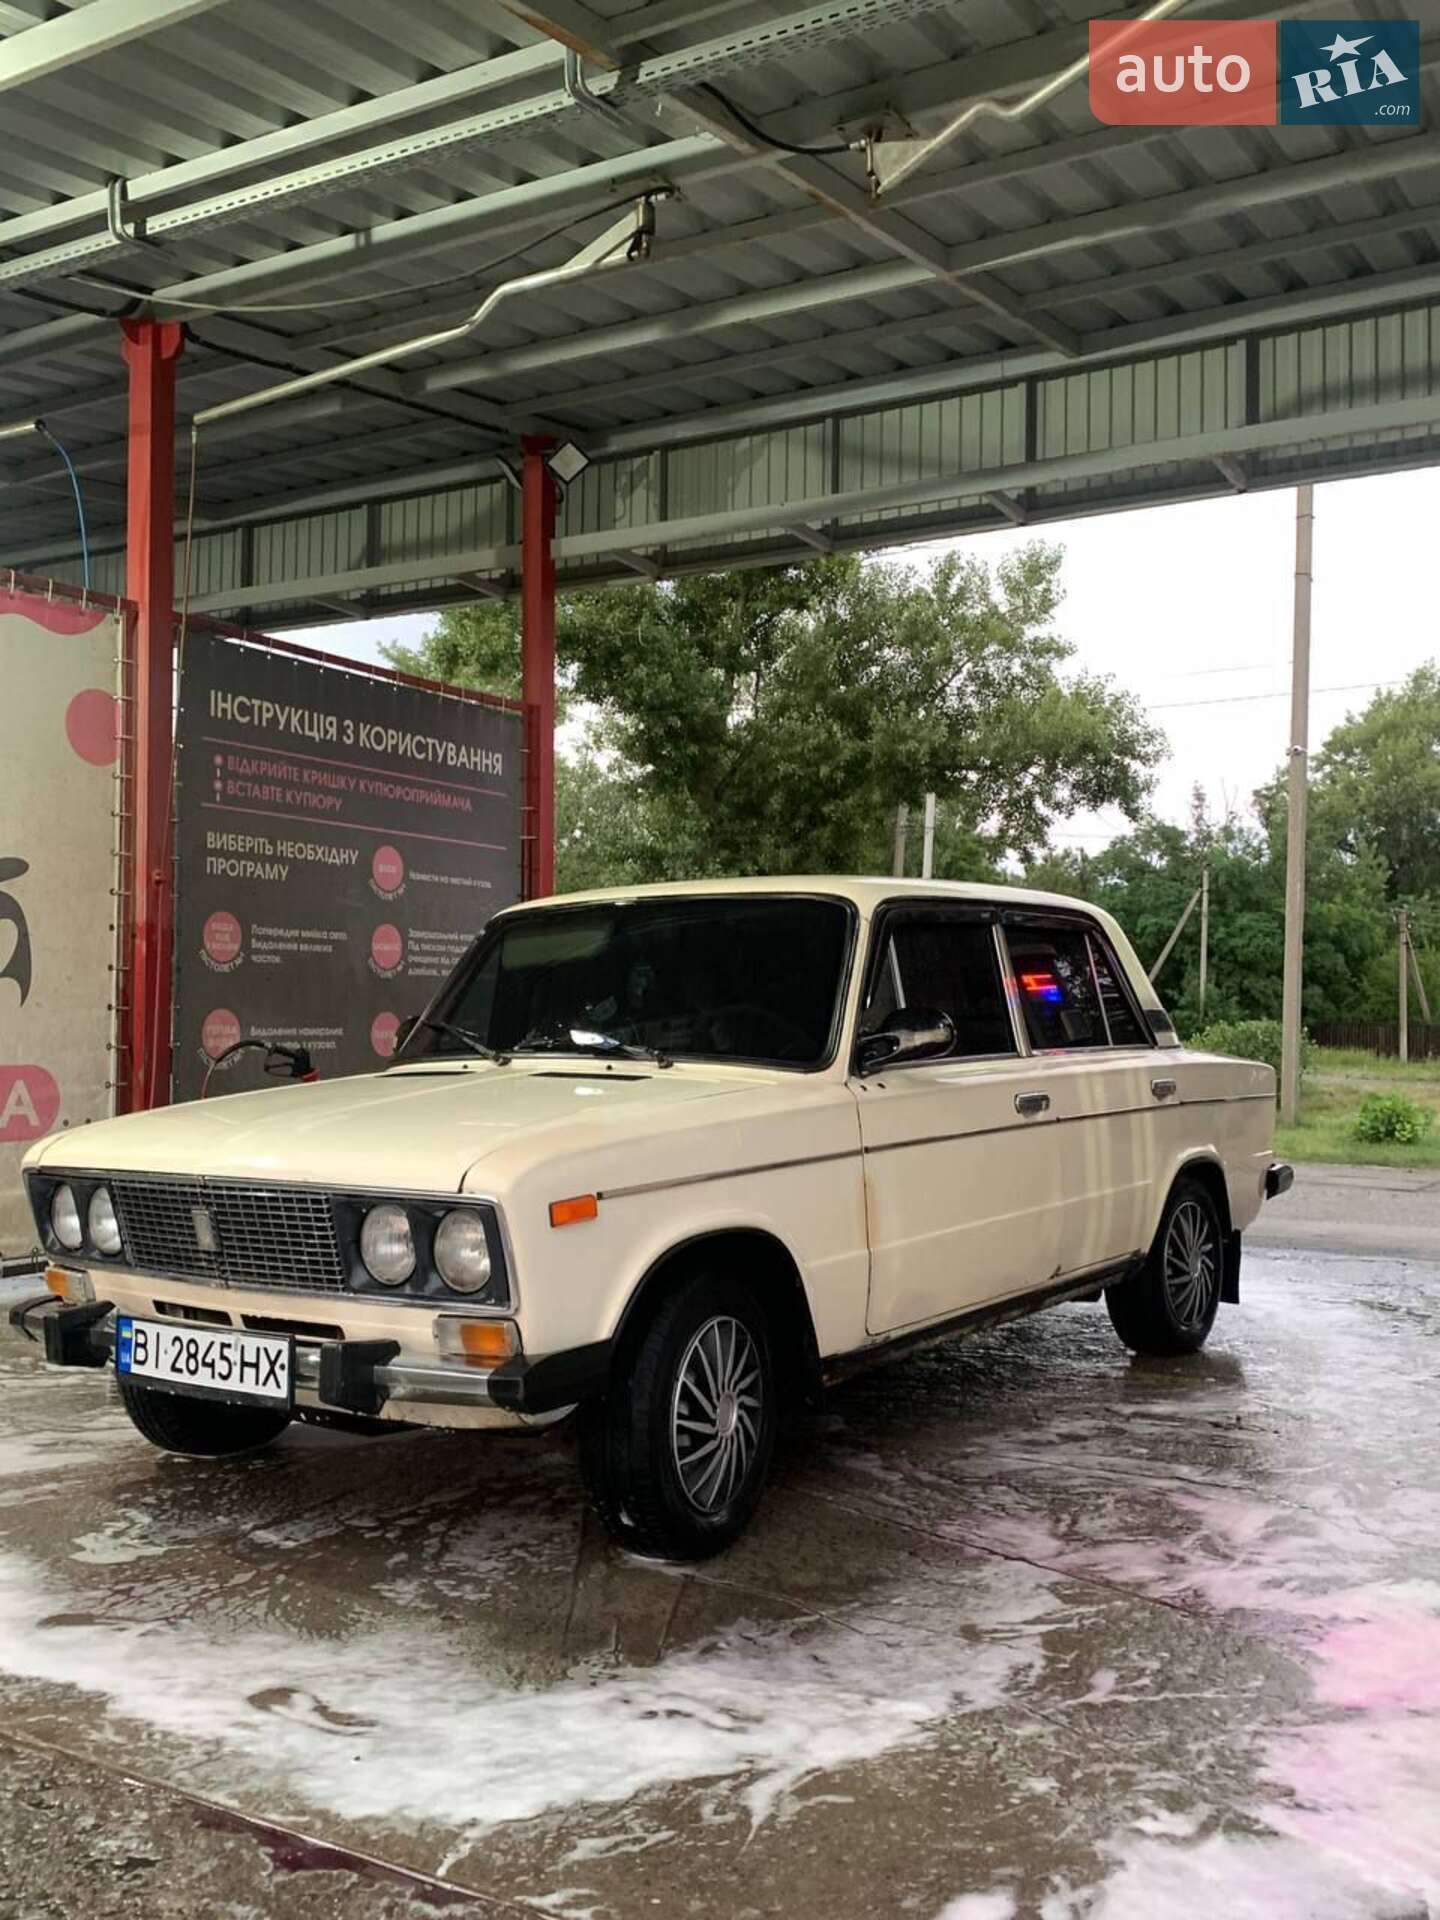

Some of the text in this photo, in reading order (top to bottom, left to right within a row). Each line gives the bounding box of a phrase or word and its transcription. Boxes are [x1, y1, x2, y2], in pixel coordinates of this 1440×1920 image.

[210, 689, 502, 776] ІНСТРУКЦІЯ З КОРИСТУВАННЯ
[227, 755, 300, 781] ВІДКРИЙТЕ
[303, 769, 357, 791] КРИШКУ
[227, 780, 342, 811] ВСТАВТЕ КУПЮРУ
[206, 831, 359, 866] ВИБЕРІТЬ НЕОБХІДНУ
[206, 856, 289, 881] ПРОГРАМУ
[133, 1328, 282, 1389] BI 2845 HX
